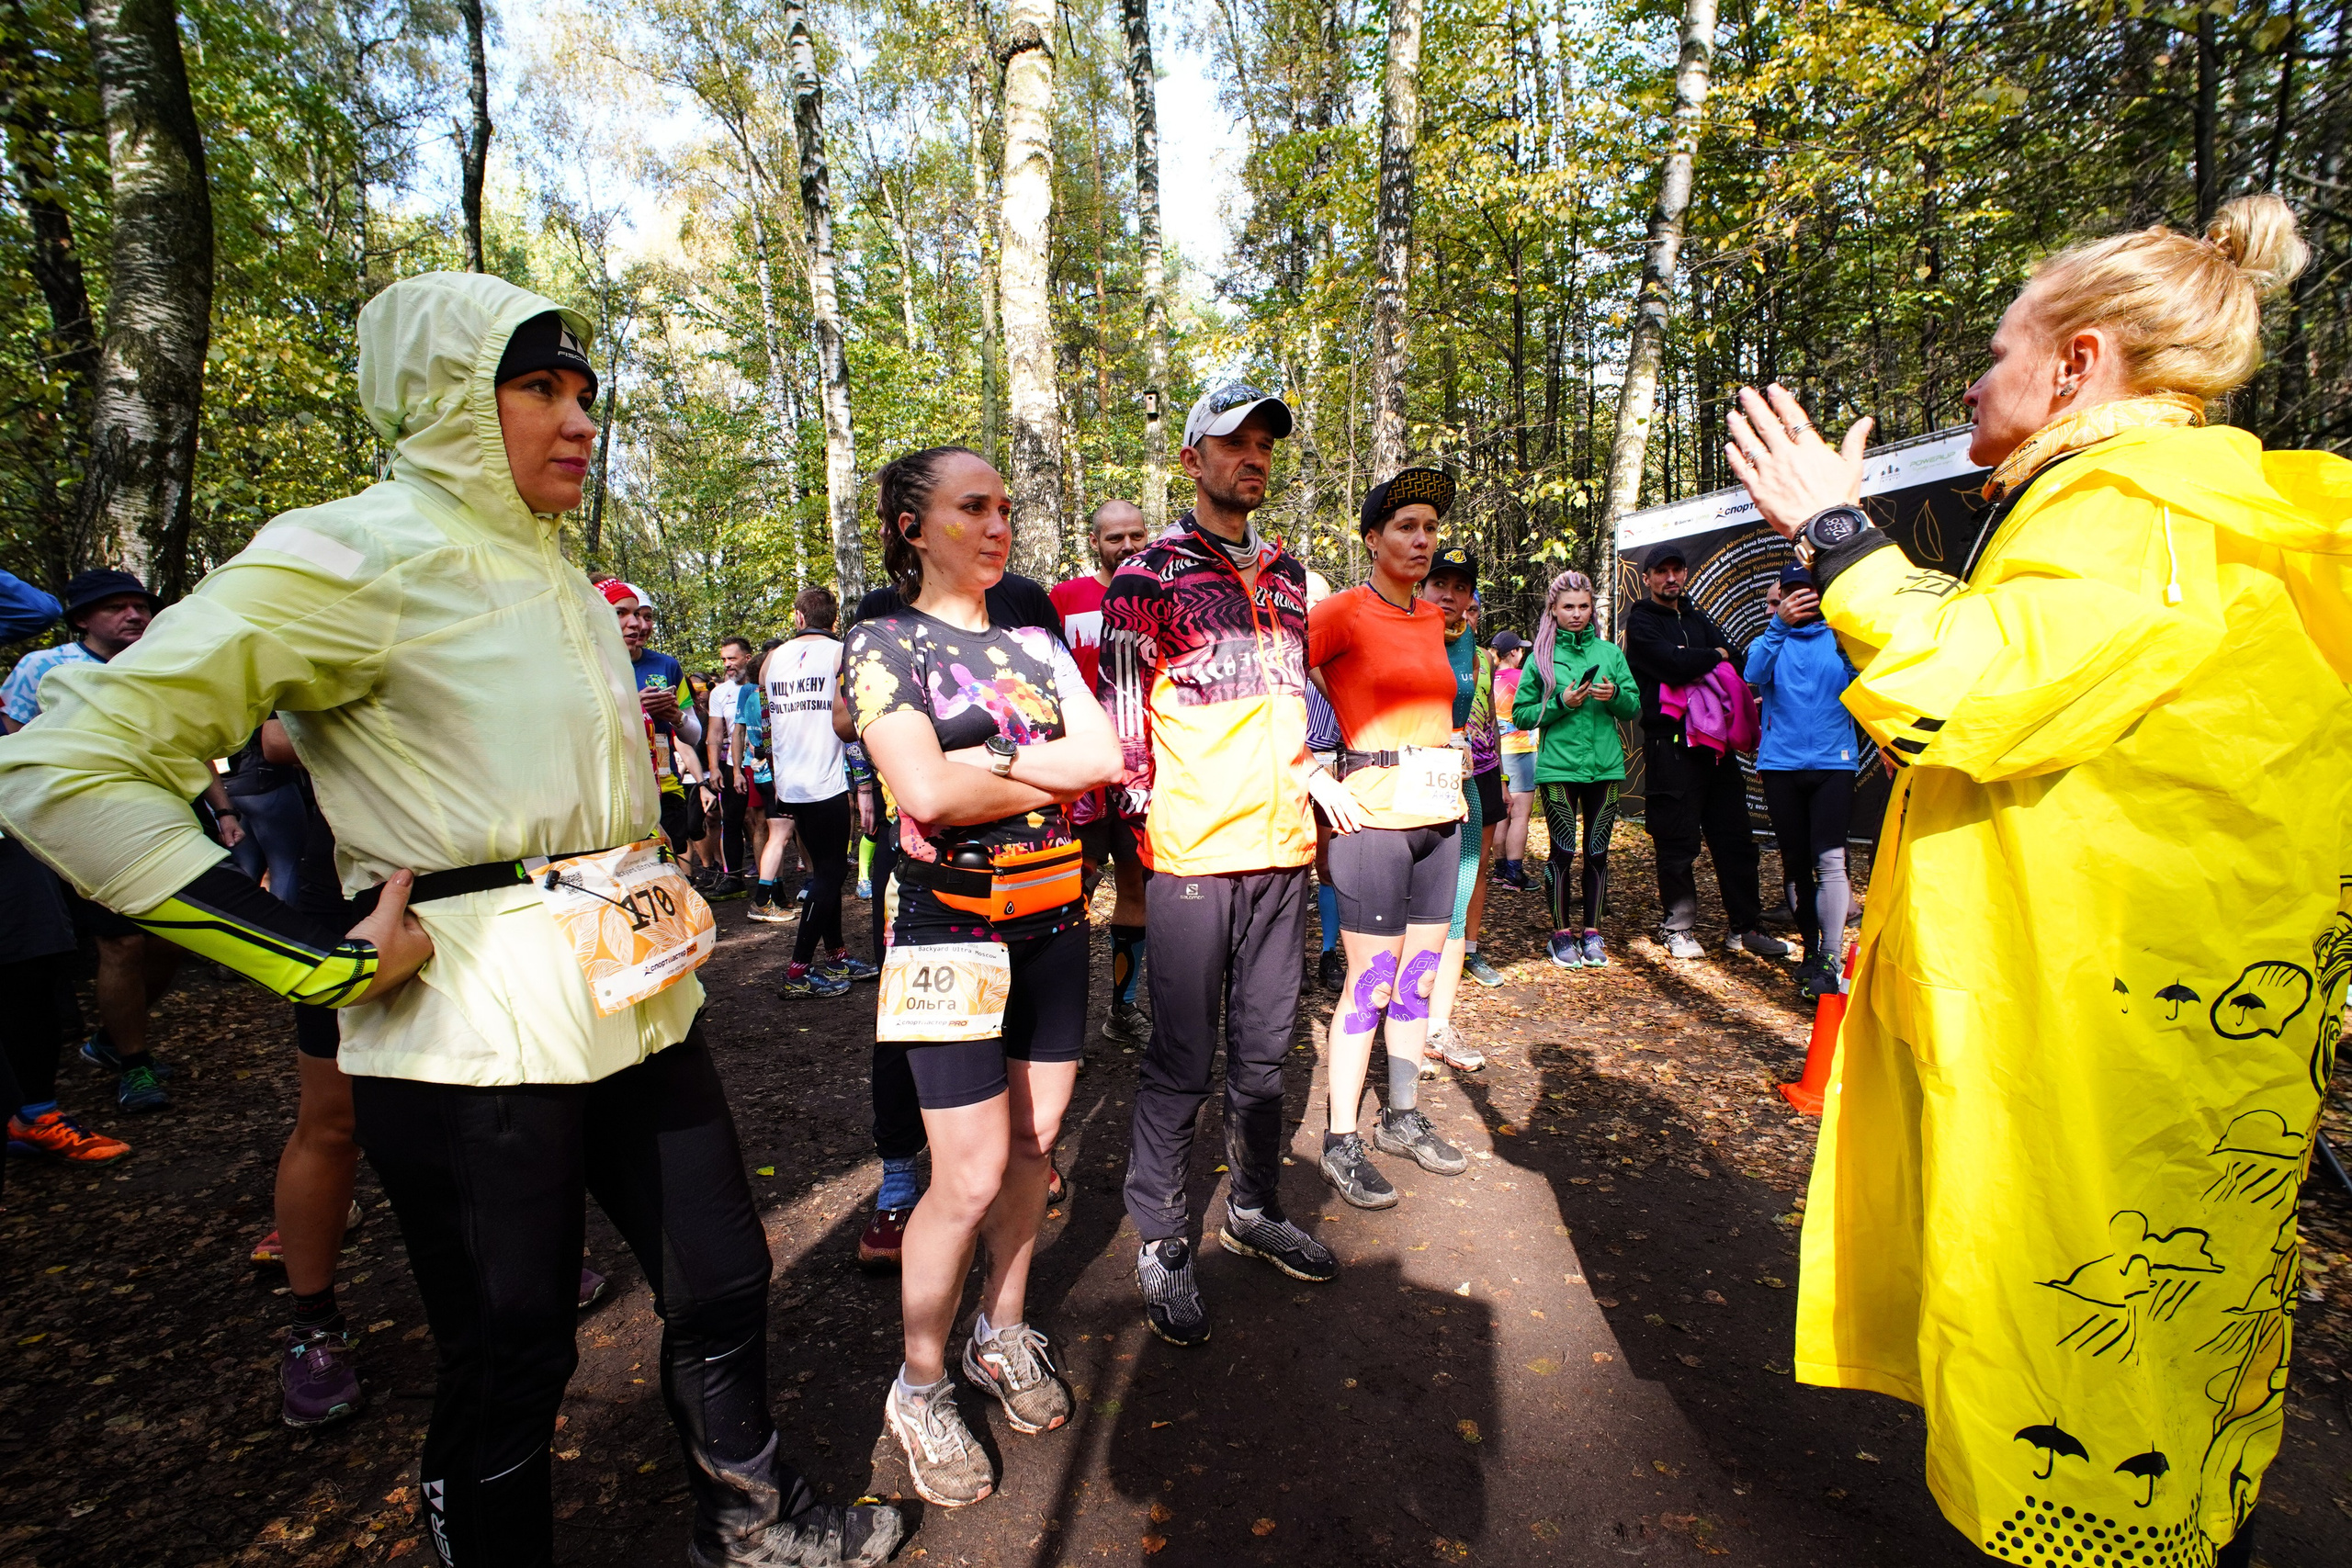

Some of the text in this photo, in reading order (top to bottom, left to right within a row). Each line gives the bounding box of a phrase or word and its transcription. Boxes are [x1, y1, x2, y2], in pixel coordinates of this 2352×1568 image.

[1701, 547, 1726, 570] Екатерина
[1726, 531, 1756, 549] Айзенберг
[1720, 547, 1743, 563] Боброва
[1743, 540, 1757, 550] Анна
[1702, 582, 1729, 610] Кузнецова
[1728, 568, 1751, 584] Татьяна
[1752, 559, 1784, 571] Кузьмина
[771, 677, 825, 697] ИЩУ ЖЕНУ
[1425, 771, 1461, 790] 168
[620, 886, 676, 931] 170
[974, 950, 997, 959] Moscow
[912, 965, 956, 993] 40
[906, 997, 956, 1010] Ольга
